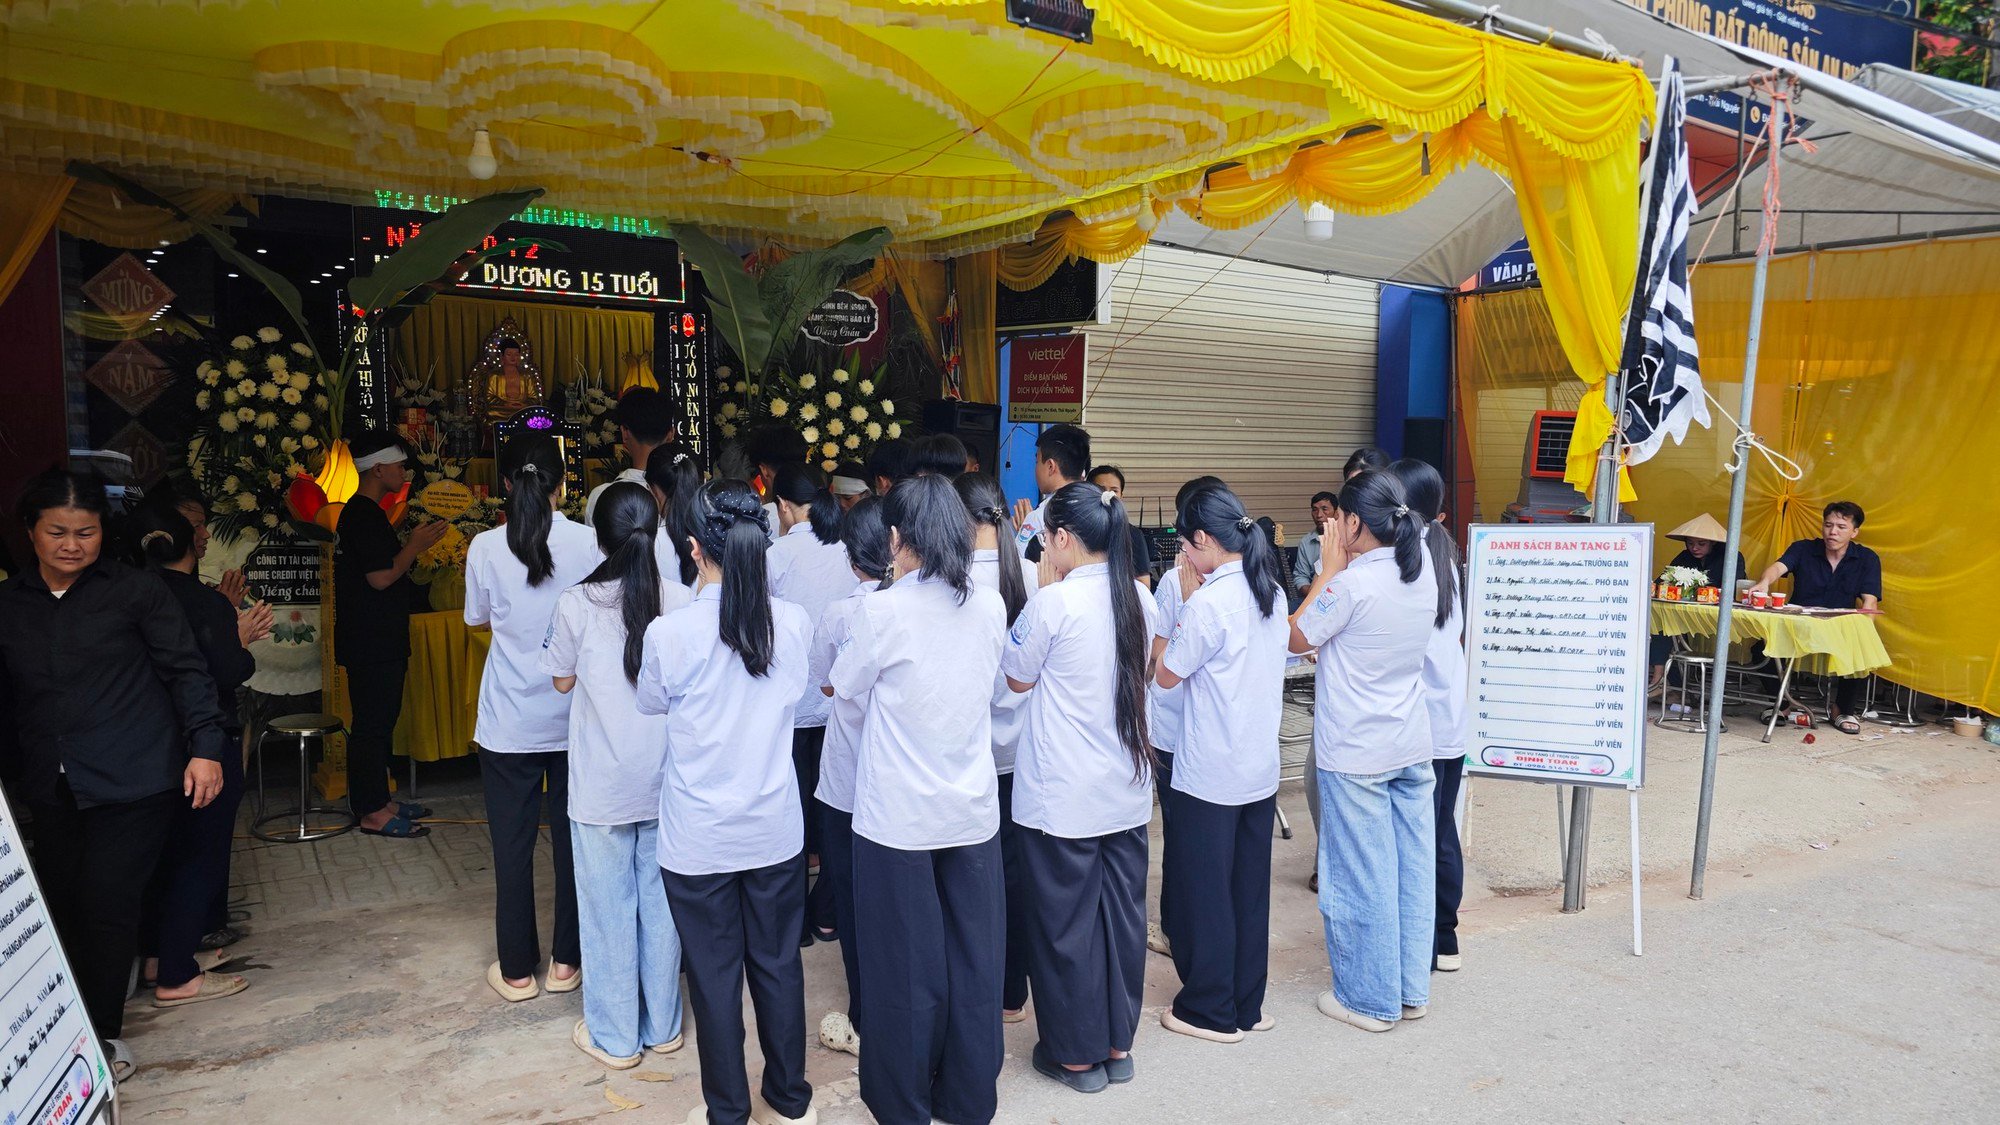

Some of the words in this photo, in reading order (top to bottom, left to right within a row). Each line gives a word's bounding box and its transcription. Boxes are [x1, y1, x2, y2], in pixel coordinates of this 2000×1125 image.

[1493, 262, 1522, 283] VĂN
[483, 263, 571, 289] DƯƠNG
[581, 270, 604, 292] 15
[610, 270, 658, 296] TUỔI
[1028, 347, 1066, 360] viettel
[1039, 371, 1051, 381] BÁN
[1054, 385, 1075, 394] THÔNG
[1490, 541, 1521, 550] DANH
[1523, 539, 1552, 550] SÁCH
[1554, 541, 1578, 550] BAN
[1580, 541, 1610, 551] TANG
[1613, 537, 1627, 551] LỄ
[256, 553, 276, 565] CÔNG
[278, 555, 287, 565] TY
[289, 553, 300, 565] TÀI
[301, 553, 320, 565] CHÍN
[1584, 556, 1612, 567] TRƯỞNG
[1613, 560, 1629, 568] BAN
[248, 570, 269, 580] HOME
[271, 570, 297, 580] CREDIT
[298, 568, 313, 582] VIỆT
[1595, 576, 1611, 586] PHÓ
[1611, 594, 1628, 604] VIÊN
[1611, 612, 1628, 622] VIÊN
[1610, 629, 1627, 640] VIÊN
[1609, 647, 1626, 657] VIÊN
[1608, 665, 1625, 675] VIÊN
[1607, 683, 1625, 693] VIÊN
[1607, 701, 1624, 711] VIÊN
[1607, 719, 1624, 729] VIÊN
[1606, 738, 1622, 749] VIÊN
